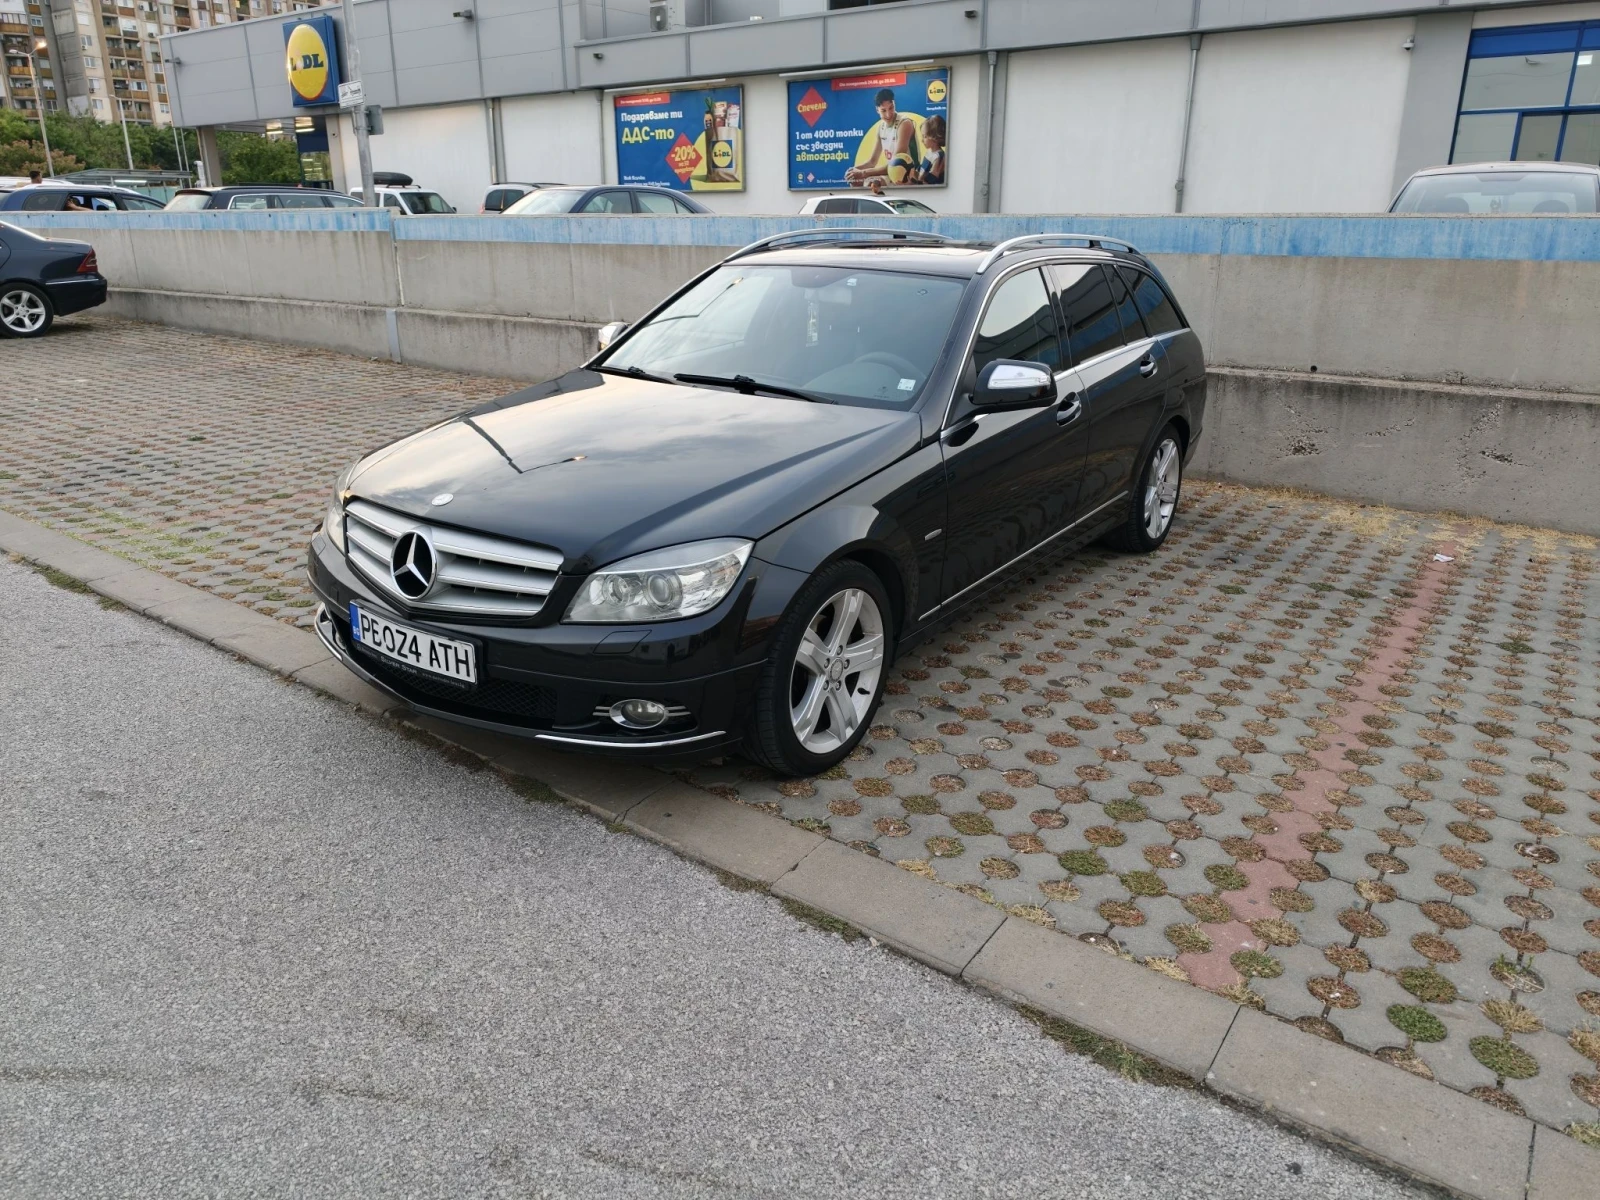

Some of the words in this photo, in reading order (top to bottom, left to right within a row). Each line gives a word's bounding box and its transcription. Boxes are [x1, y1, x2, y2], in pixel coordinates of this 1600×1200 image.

[797, 102, 827, 113] Спечели
[621, 110, 669, 123] Подаряваме
[670, 111, 683, 119] ти
[796, 132, 800, 140] 1
[800, 132, 813, 140] от
[814, 129, 835, 139] 4000
[836, 128, 864, 138] топки
[796, 143, 810, 151] със
[810, 141, 844, 152] звездни
[671, 145, 697, 162] -20%
[796, 150, 850, 163] автографи
[429, 639, 470, 678] ATH
